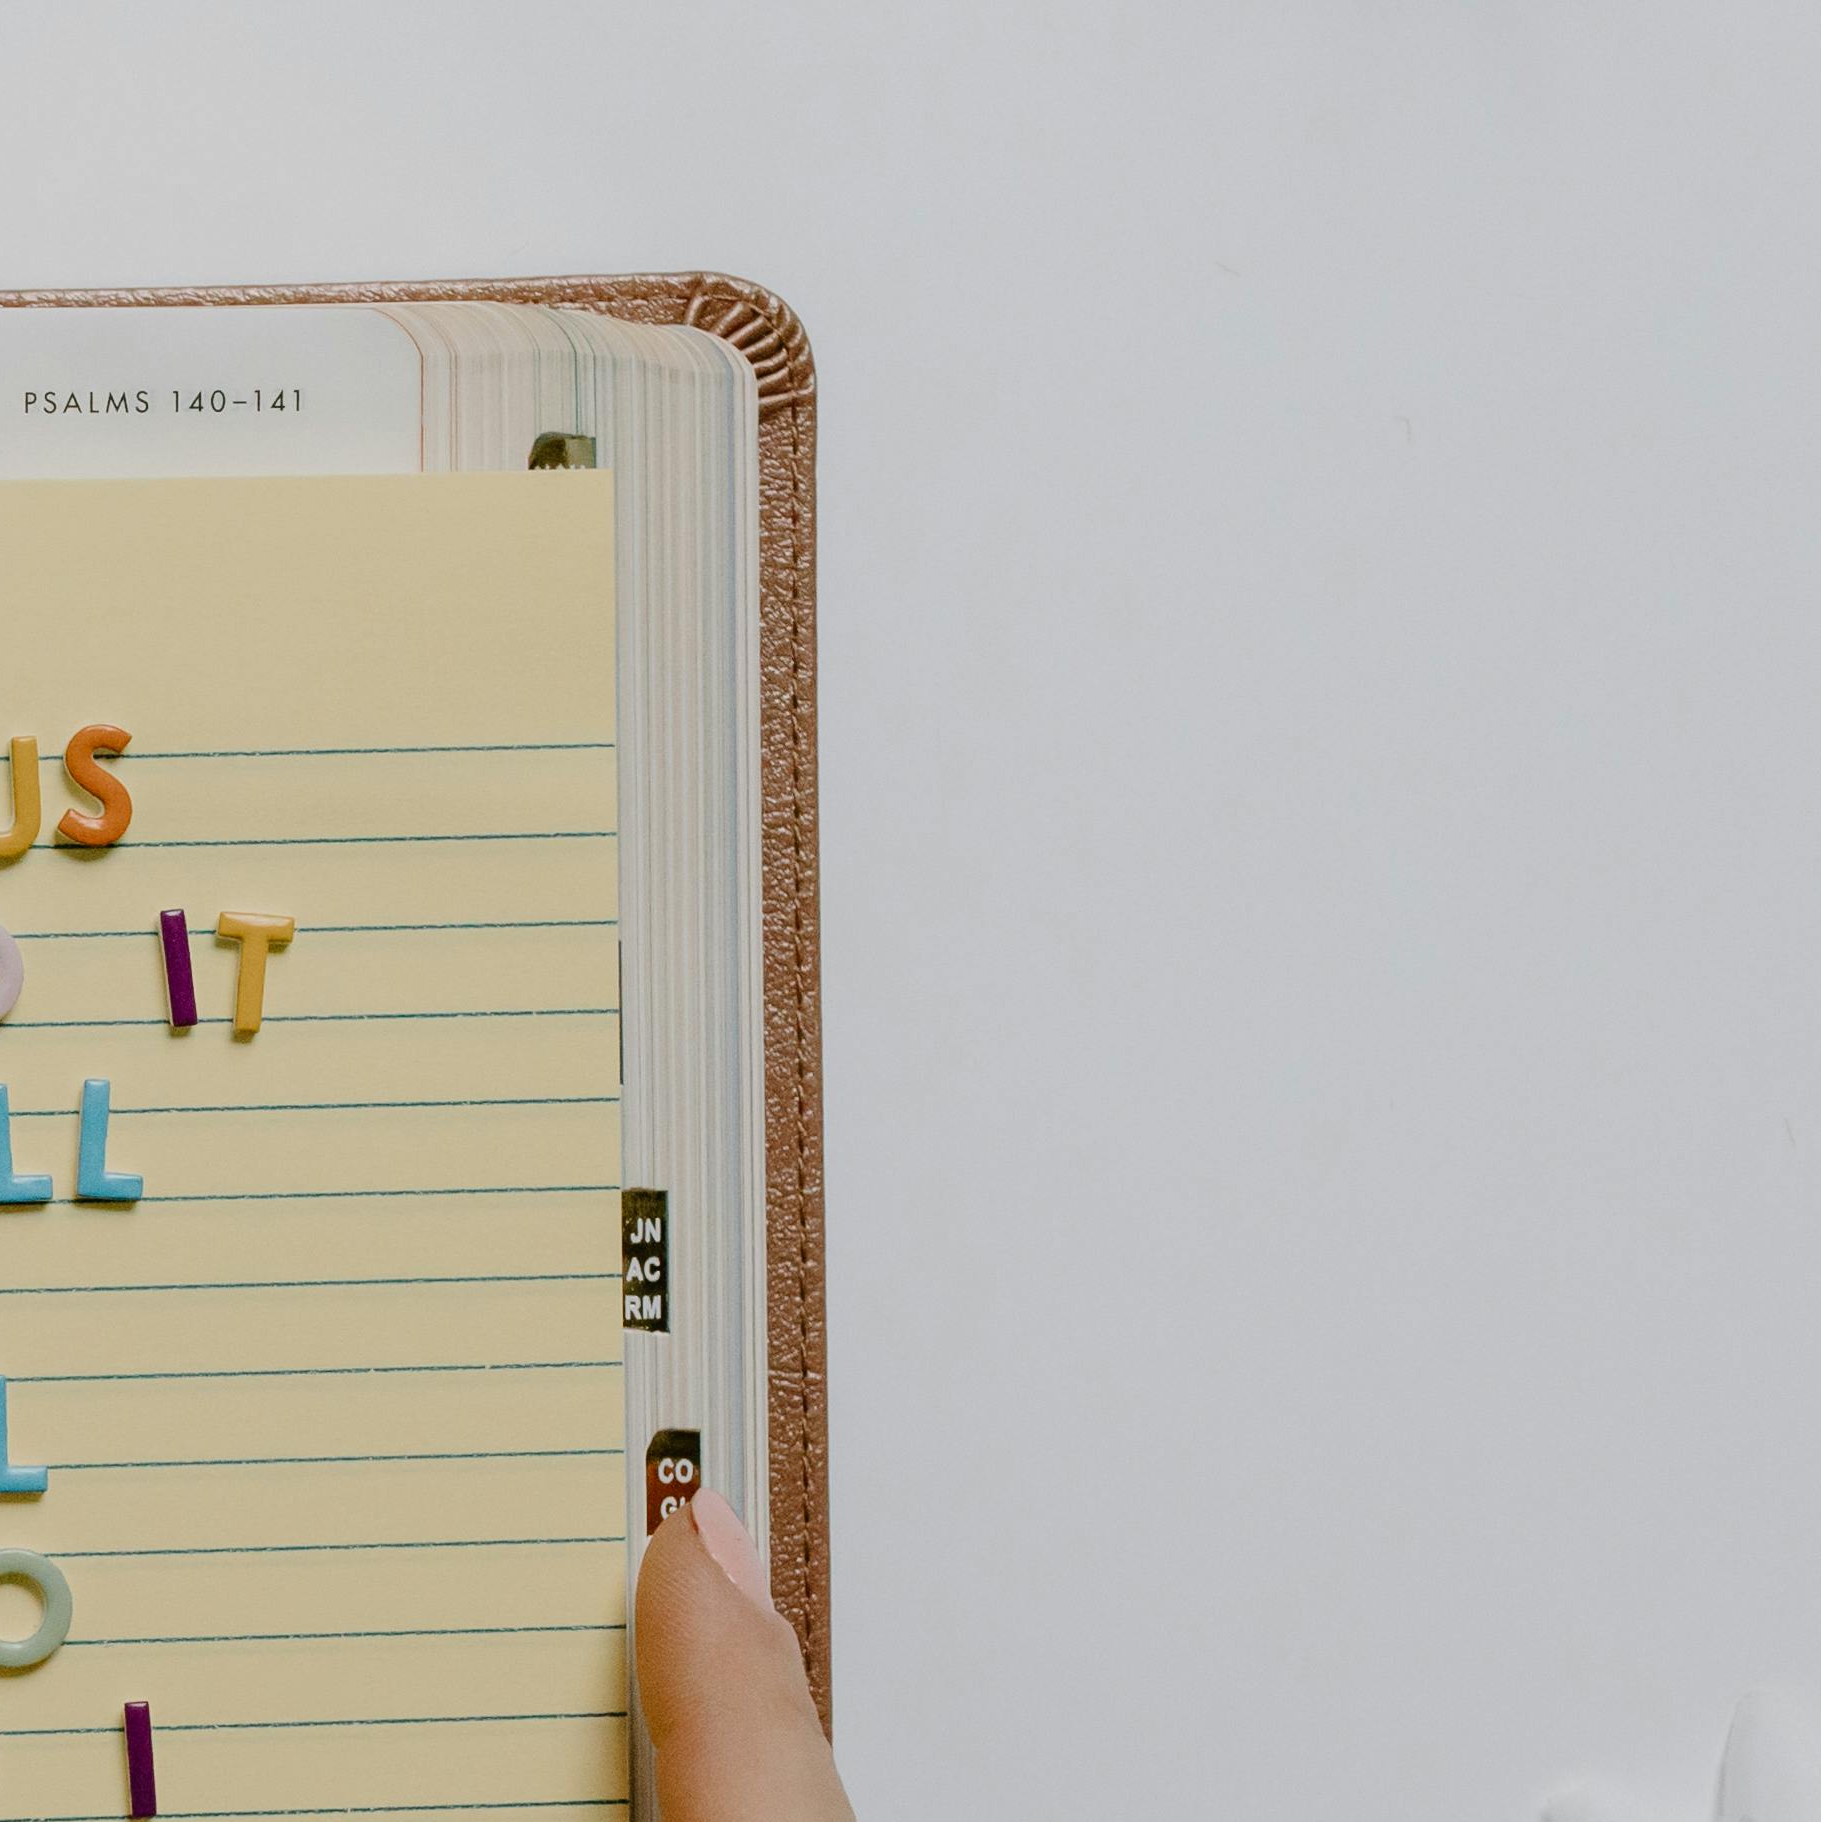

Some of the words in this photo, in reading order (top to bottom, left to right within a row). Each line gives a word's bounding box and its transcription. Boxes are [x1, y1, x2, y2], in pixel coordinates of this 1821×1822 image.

[23, 389, 150, 416] PSALMS
[157, 907, 296, 1035] IT
[629, 1217, 662, 1244] JN
[624, 1256, 662, 1283] AC
[624, 1294, 662, 1321] RM
[657, 1457, 695, 1485] CO
[123, 1700, 158, 1820] I
